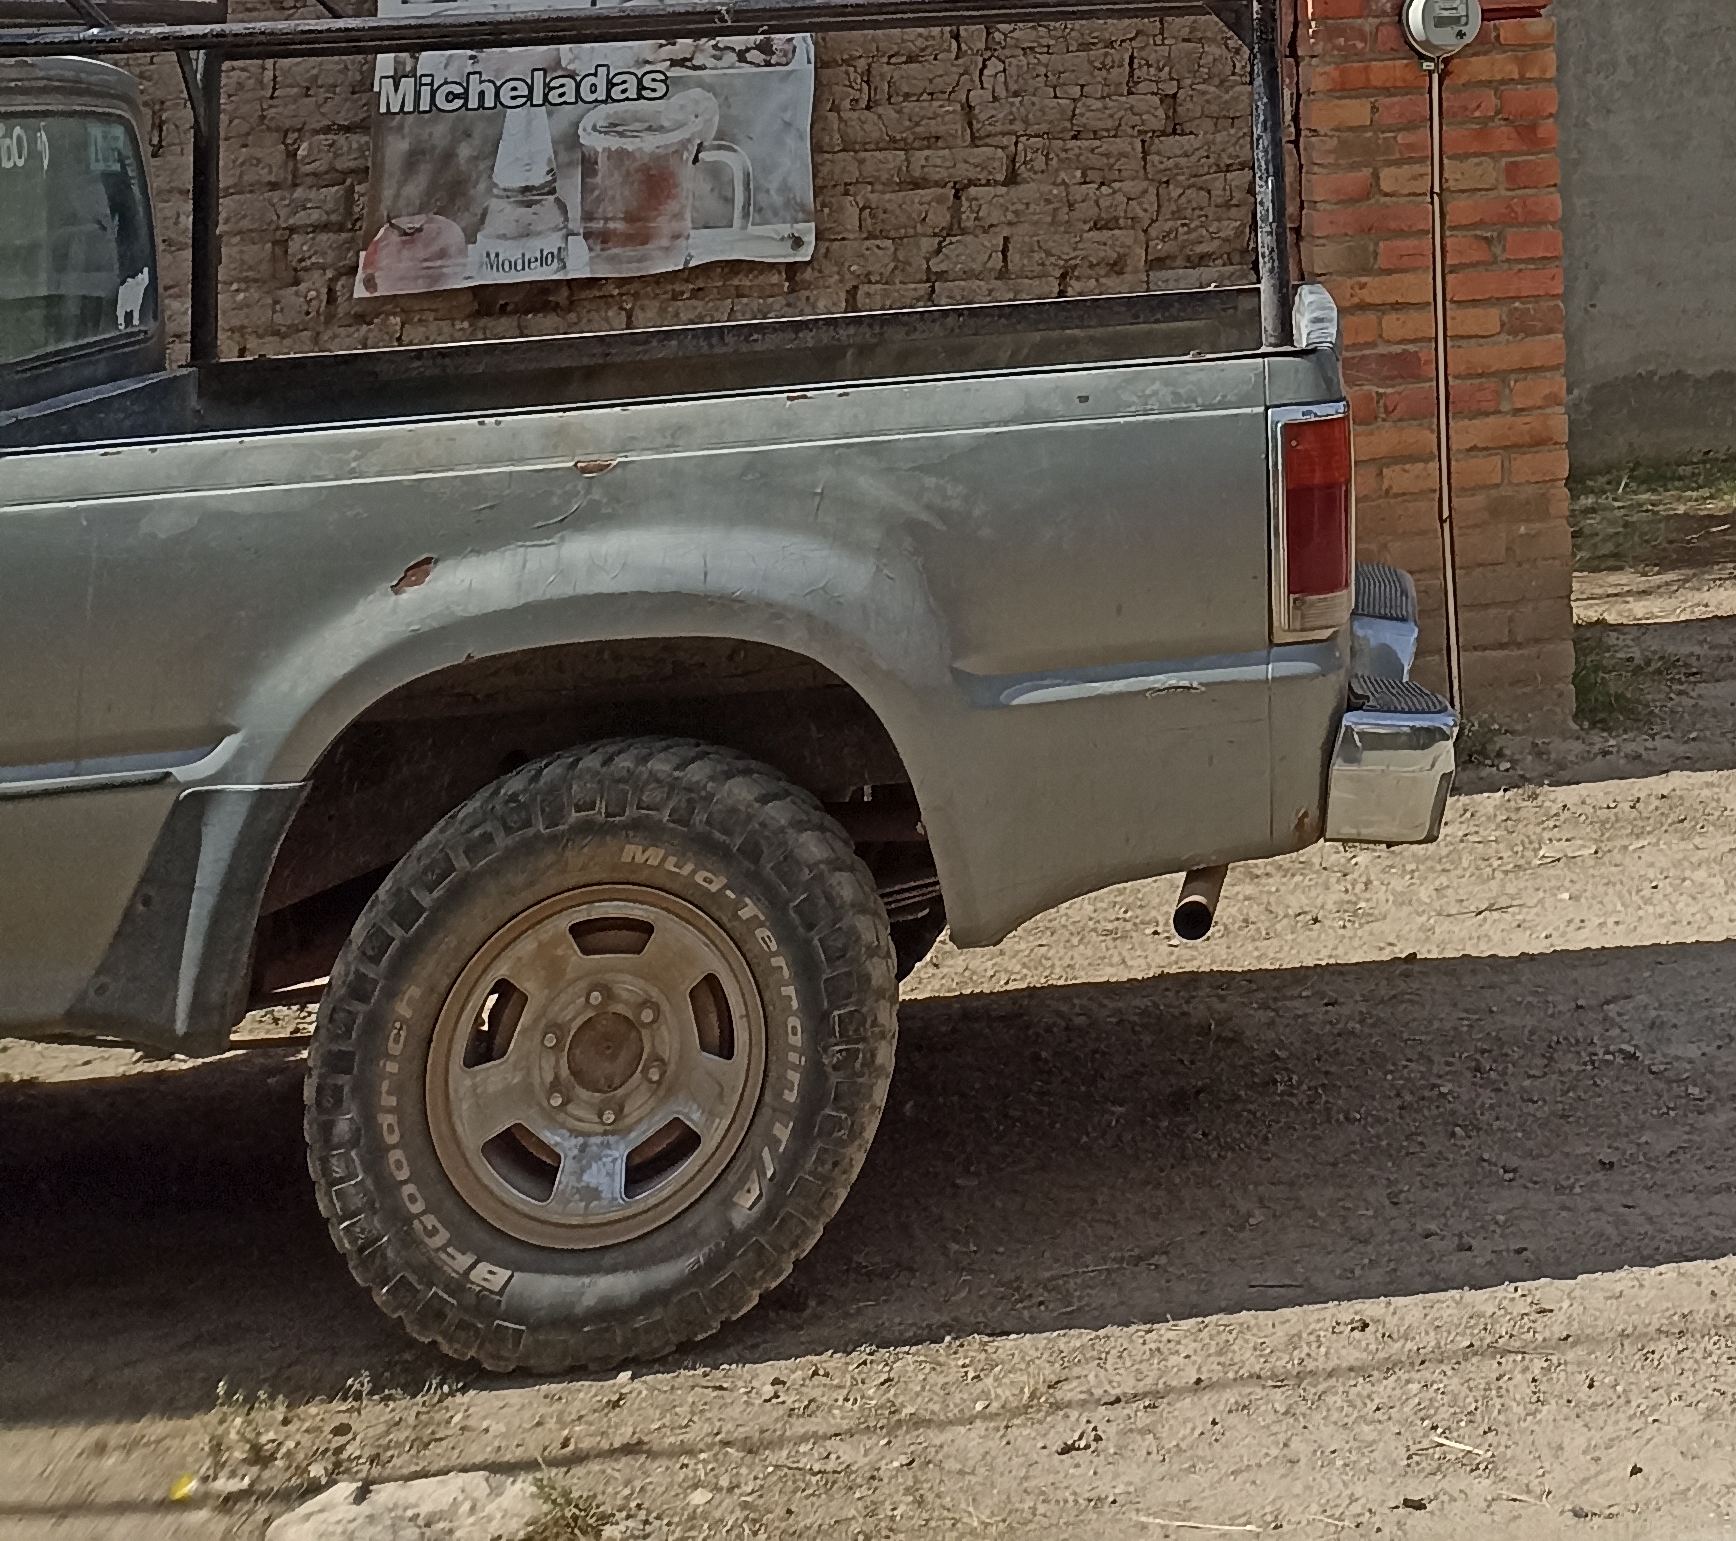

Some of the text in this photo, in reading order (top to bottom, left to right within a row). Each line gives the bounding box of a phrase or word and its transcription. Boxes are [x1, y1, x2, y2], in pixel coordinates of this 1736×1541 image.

[378, 63, 670, 114] Micheladas
[485, 247, 555, 273] Modelo
[620, 843, 806, 1212] Mud-Terrain T/A
[377, 984, 515, 1293] BFGoodrich
